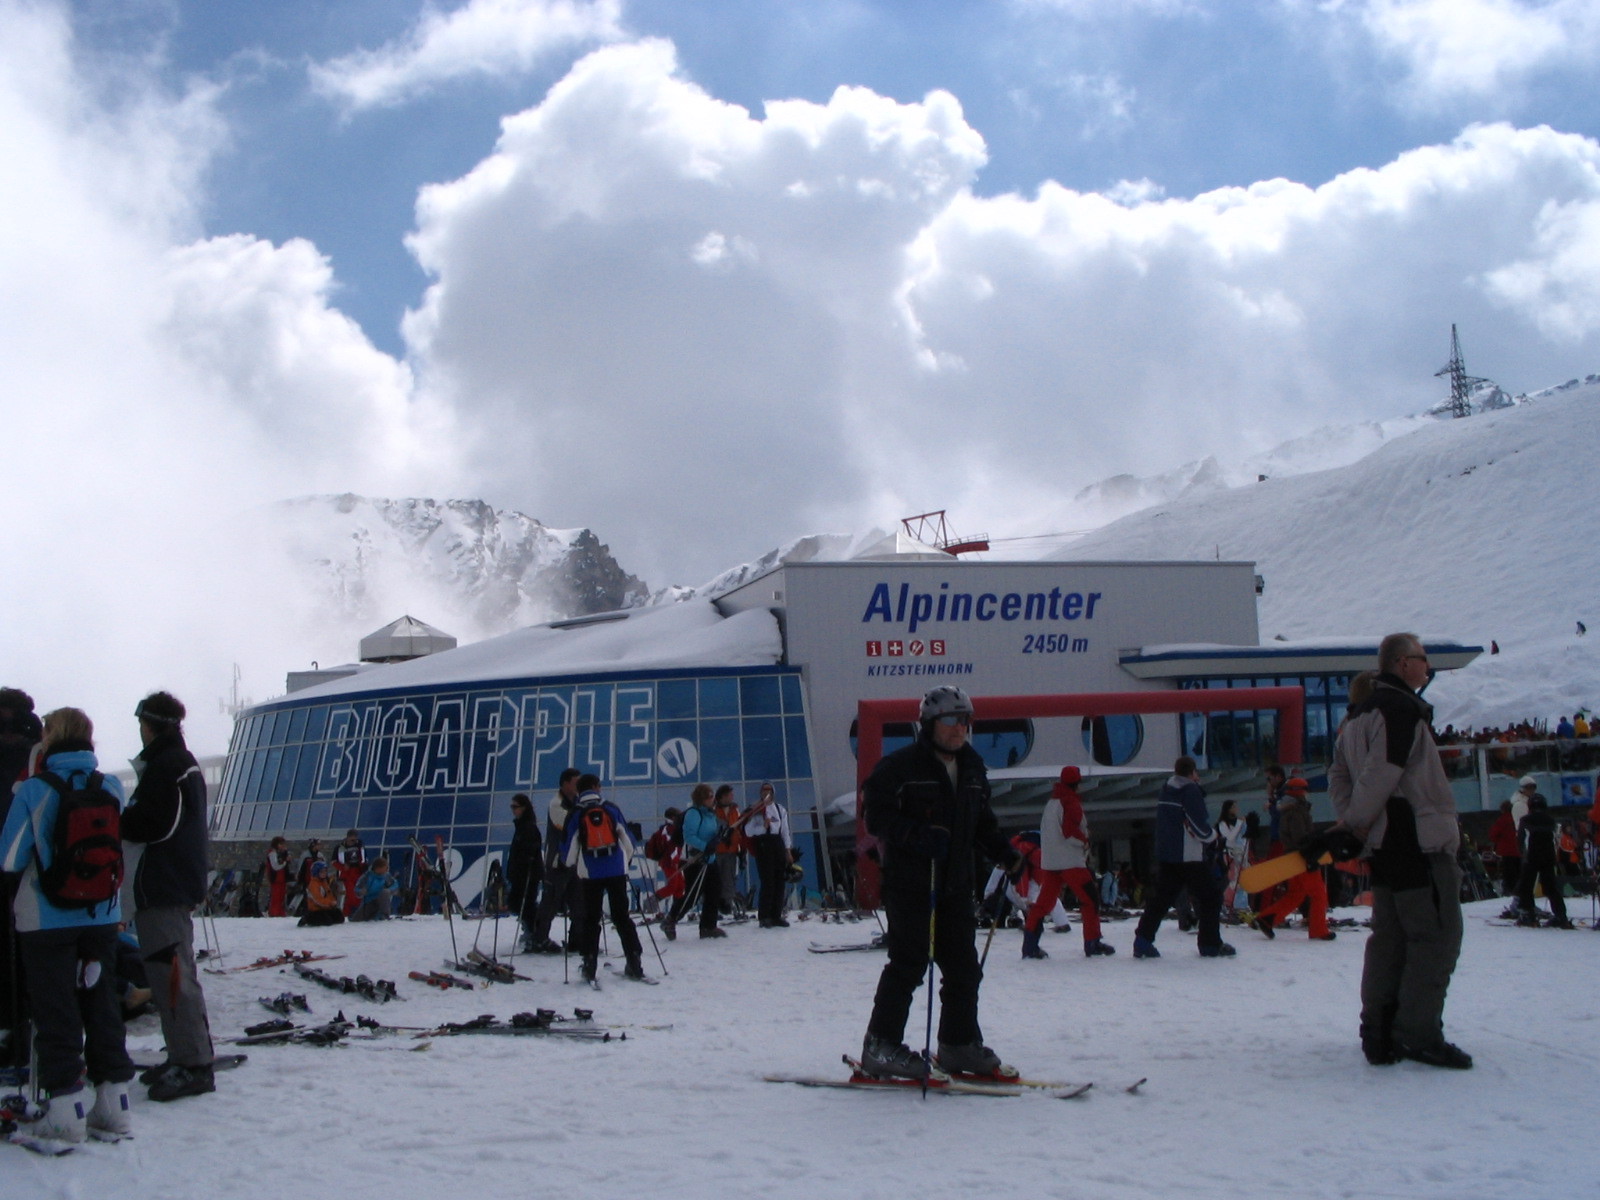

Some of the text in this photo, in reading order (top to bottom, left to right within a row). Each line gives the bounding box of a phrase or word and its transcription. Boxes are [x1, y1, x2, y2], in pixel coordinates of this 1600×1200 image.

[862, 582, 1102, 633] Alpincenter
[1022, 634, 1089, 654] 2450 m
[867, 663, 974, 677] KITZSTEINHORN
